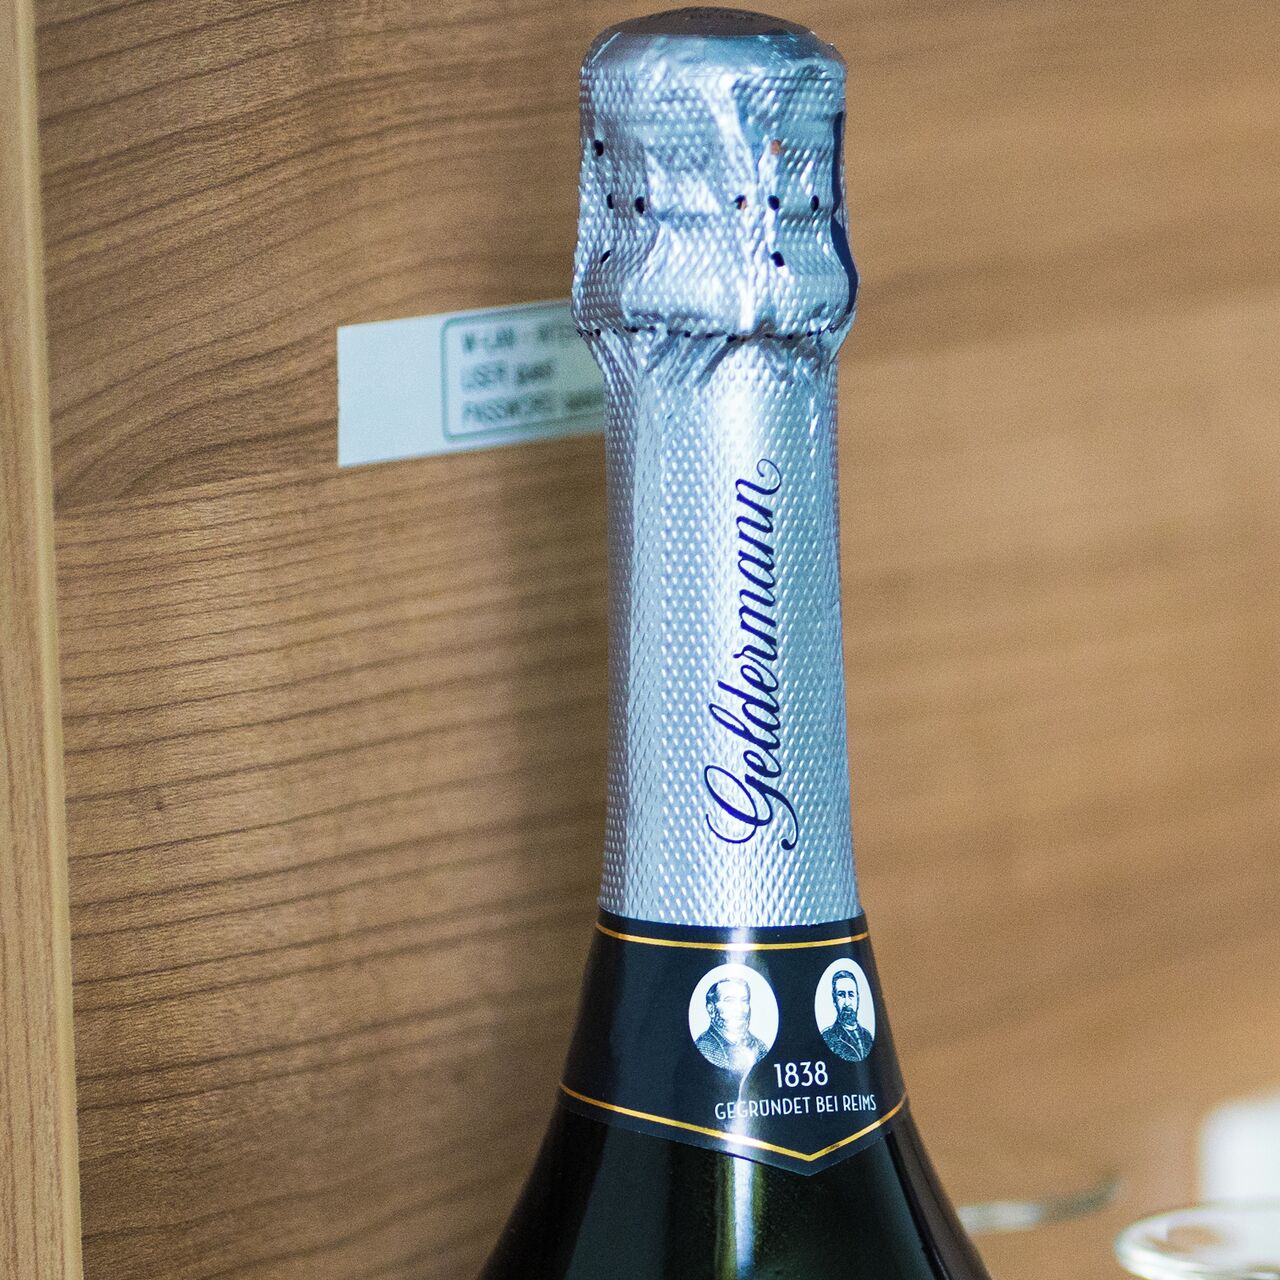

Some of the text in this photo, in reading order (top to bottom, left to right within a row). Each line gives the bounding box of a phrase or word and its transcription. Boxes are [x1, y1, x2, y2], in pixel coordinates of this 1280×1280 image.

[703, 458, 799, 851] Geldermann
[773, 1060, 828, 1088] 1838
[714, 1094, 877, 1120] GEGRÜNDET BEI REIMS
